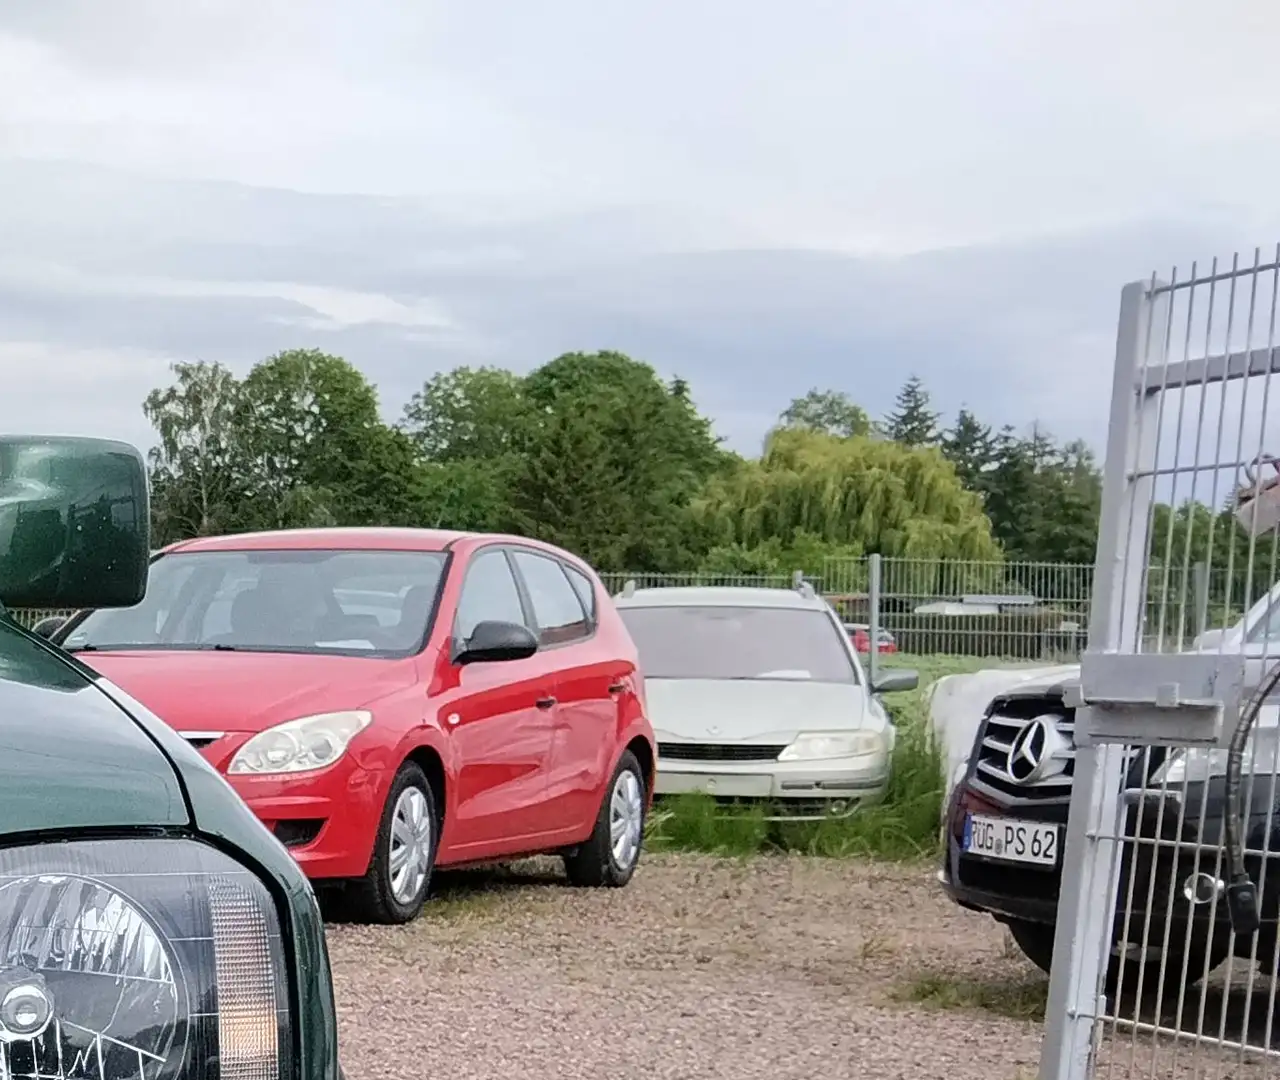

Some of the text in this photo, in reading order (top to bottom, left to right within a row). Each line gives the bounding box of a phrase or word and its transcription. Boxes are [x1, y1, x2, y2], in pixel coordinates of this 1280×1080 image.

[970, 820, 1055, 859] RÜG PS 62
